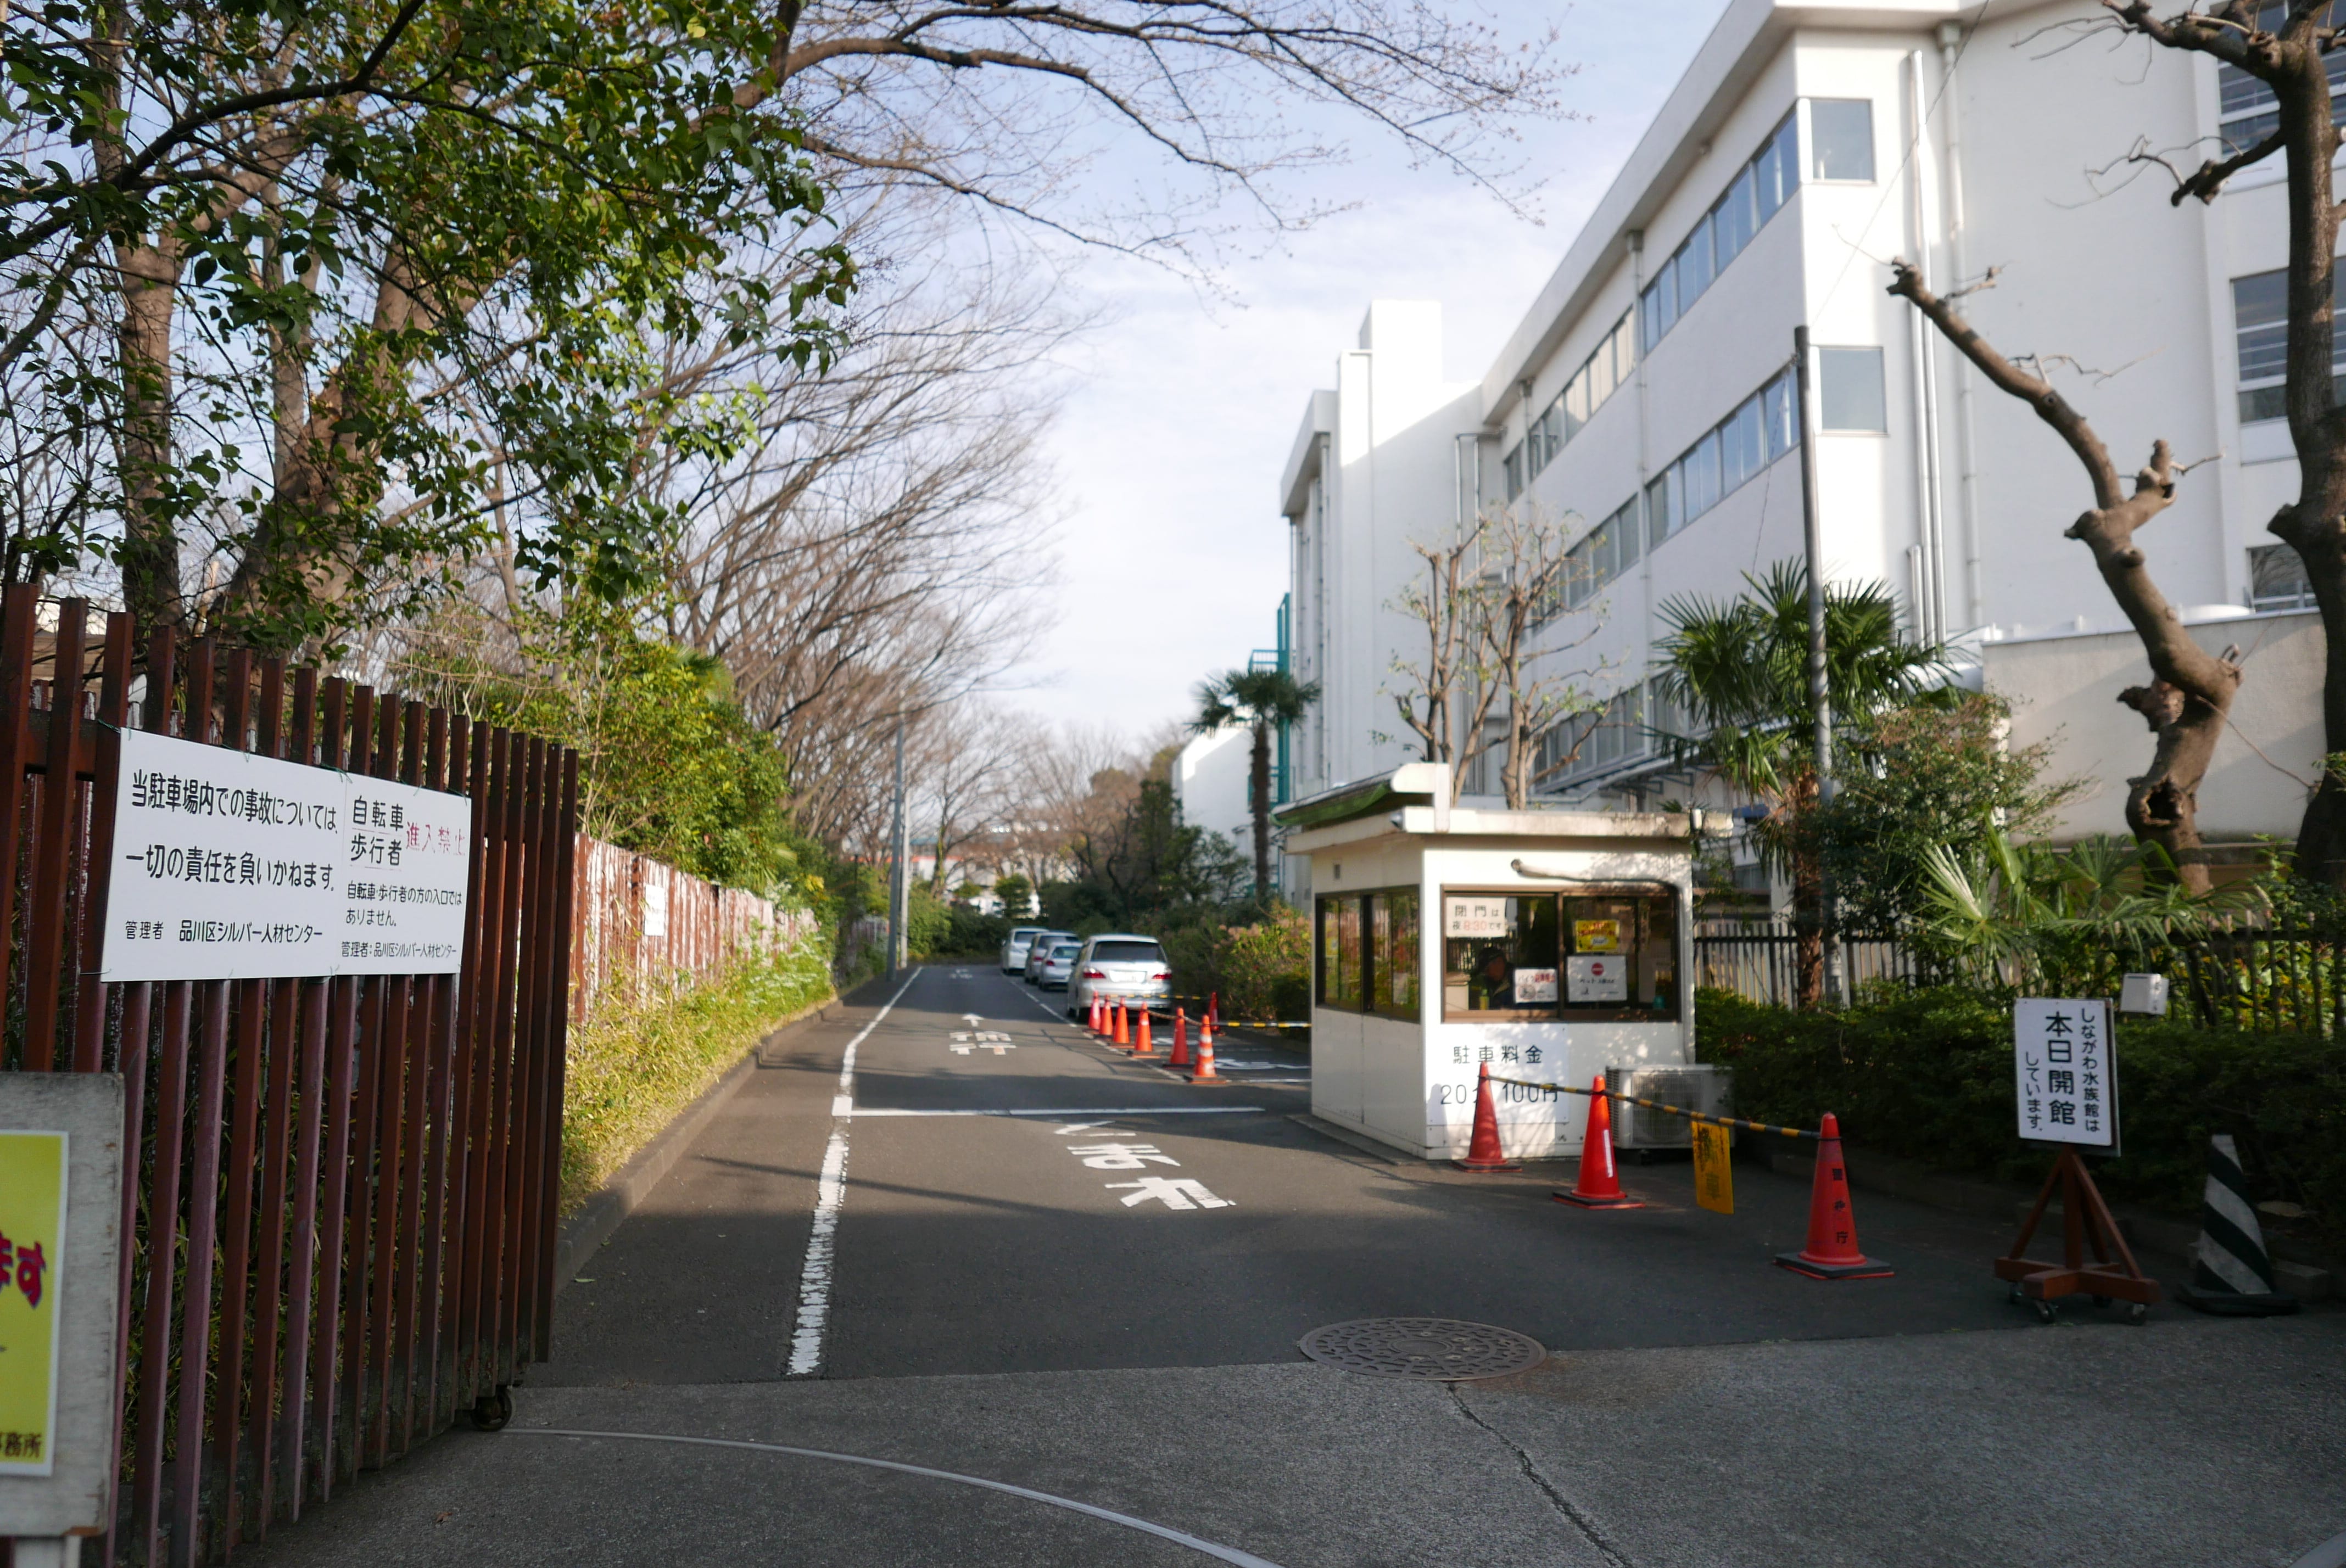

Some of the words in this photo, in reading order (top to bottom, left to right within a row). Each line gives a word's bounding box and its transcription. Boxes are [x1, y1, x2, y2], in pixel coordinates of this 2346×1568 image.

[131, 769, 338, 834] 当駐車場内での事故については、
[353, 795, 404, 831] 自転車
[350, 832, 403, 866] 歩行者
[406, 821, 466, 856] 進入禁止
[126, 844, 334, 892] 一切の責任を負いかねます。
[125, 920, 164, 939] 管理者
[179, 920, 323, 943] 品川区シルバー人材センター
[346, 908, 396, 926] ありません。
[1453, 1044, 1543, 1064] 駐車料金
[2045, 1011, 2076, 1125] 本日開館
[2081, 1008, 2101, 1133] しながわ水族館は
[1440, 1084, 1478, 1105] 20
[2025, 1051, 2043, 1131] しています。
